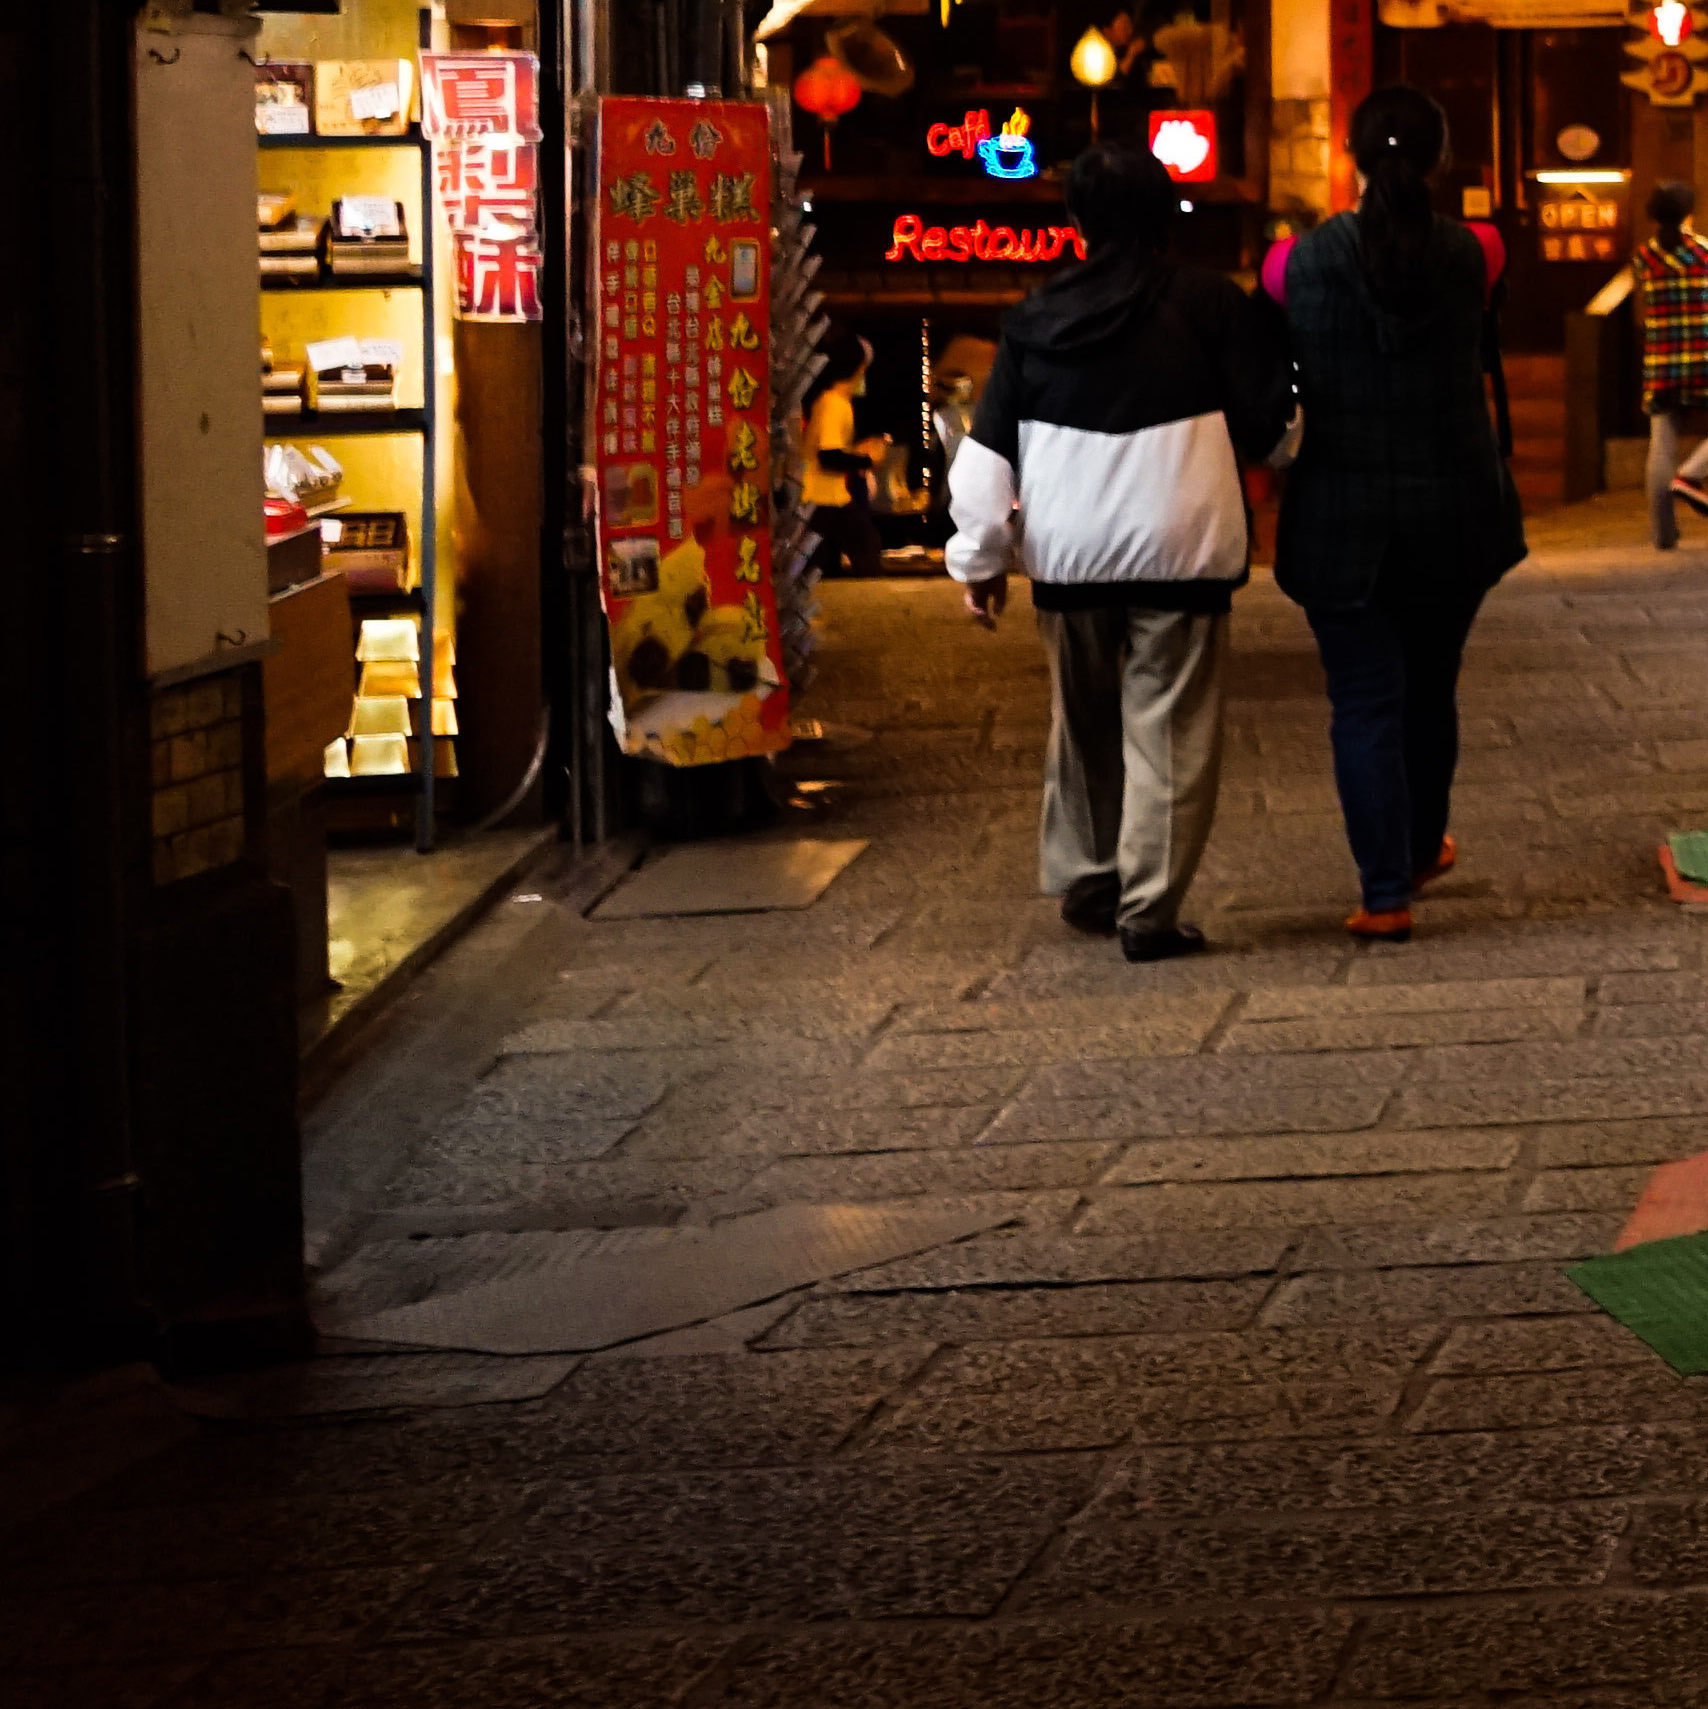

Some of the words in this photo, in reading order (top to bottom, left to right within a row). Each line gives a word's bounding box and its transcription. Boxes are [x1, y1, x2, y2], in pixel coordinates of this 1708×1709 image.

[643, 117, 724, 161] 九份
[609, 169, 761, 227] 蜂巢糕
[885, 213, 1088, 263] Restaur
